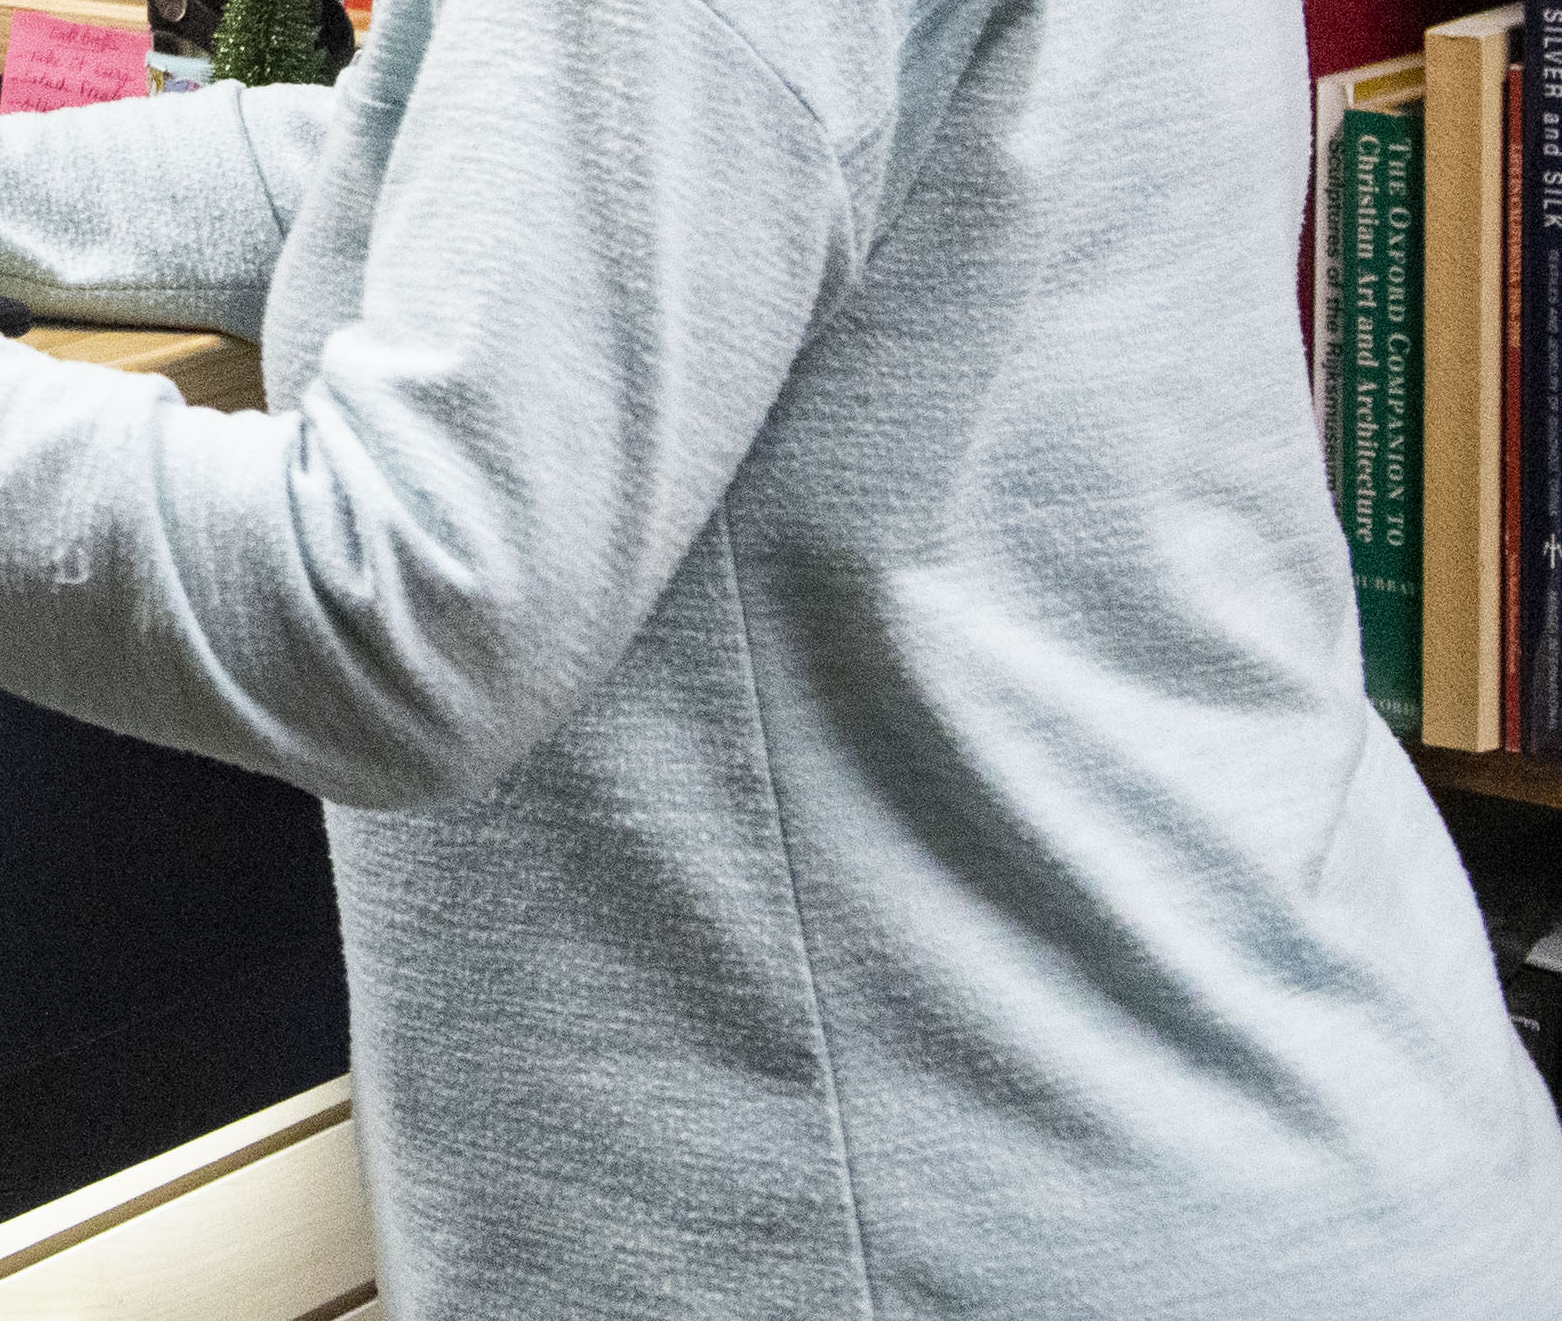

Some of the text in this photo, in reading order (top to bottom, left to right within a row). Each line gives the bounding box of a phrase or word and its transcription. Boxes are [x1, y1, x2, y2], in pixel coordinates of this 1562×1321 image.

[1324, 140, 1344, 258] Sculptures
[1543, 7, 1562, 228] SILVER and SILK
[1325, 296, 1343, 334] the
[1355, 134, 1381, 542] Christian Art and Architecture
